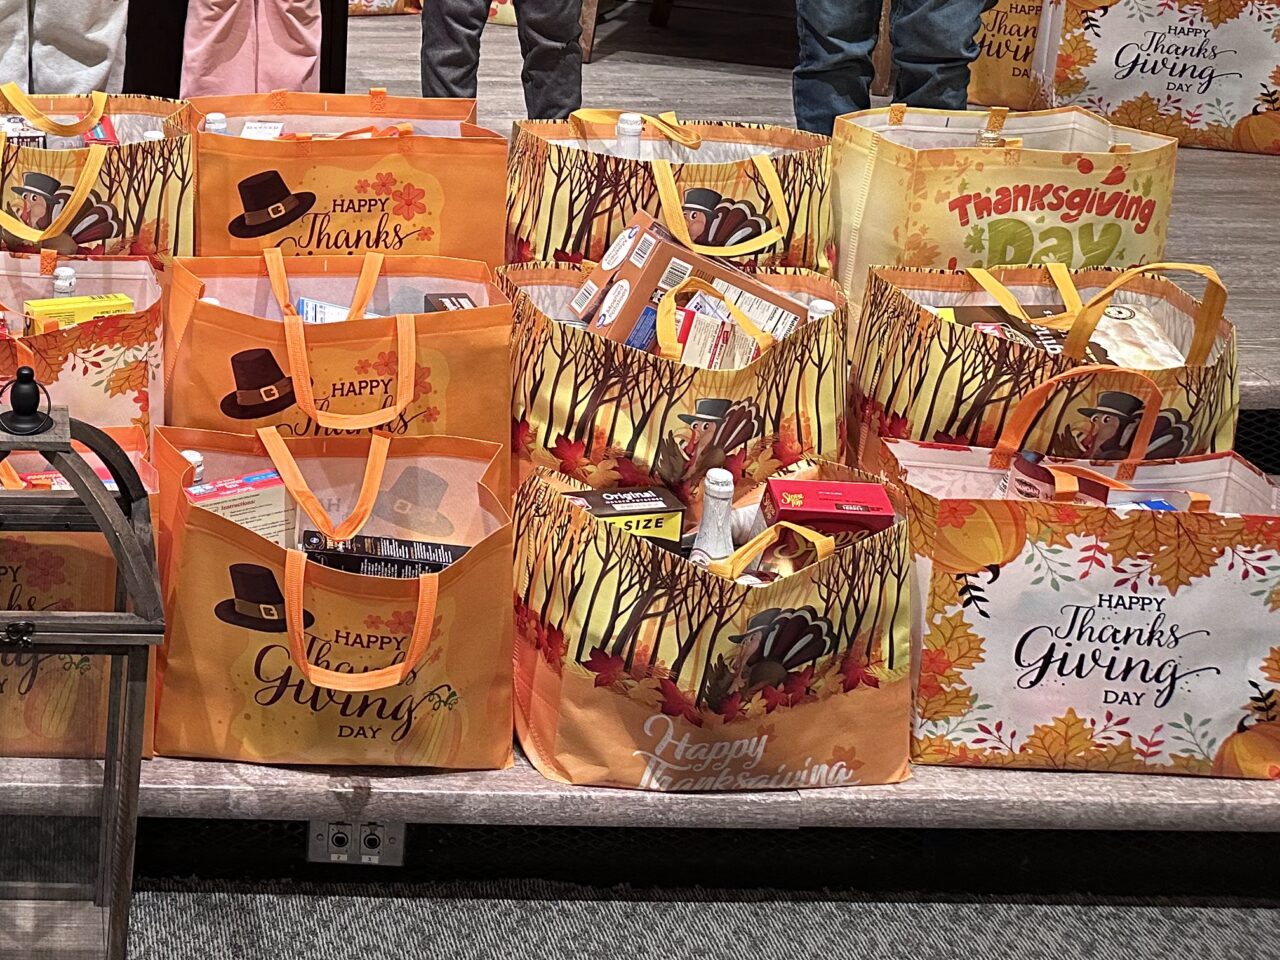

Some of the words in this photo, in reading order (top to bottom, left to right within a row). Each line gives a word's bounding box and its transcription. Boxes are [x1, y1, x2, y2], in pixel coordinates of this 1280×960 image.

[1009, 3, 1042, 16] HAPP
[987, 8, 1038, 39] Than
[1168, 25, 1211, 38] HAPPY
[1140, 30, 1237, 60] Thanks
[1012, 67, 1032, 79] DA
[1114, 42, 1242, 94] Giving
[1166, 82, 1193, 93] DAY
[332, 198, 389, 213] HAPPY
[948, 183, 1157, 234] Thanksgiving
[297, 211, 422, 250] Thanks
[332, 378, 393, 398] HAPPY
[602, 490, 657, 501] Original
[623, 517, 665, 531] SIZE
[1097, 594, 1167, 613] HAPPY
[1054, 604, 1211, 649] Thanks
[333, 629, 408, 651] HAPPY
[1014, 625, 1221, 709] Giving
[1102, 690, 1147, 706] DAY
[337, 725, 383, 740] DAY
[643, 714, 769, 771] Happy
